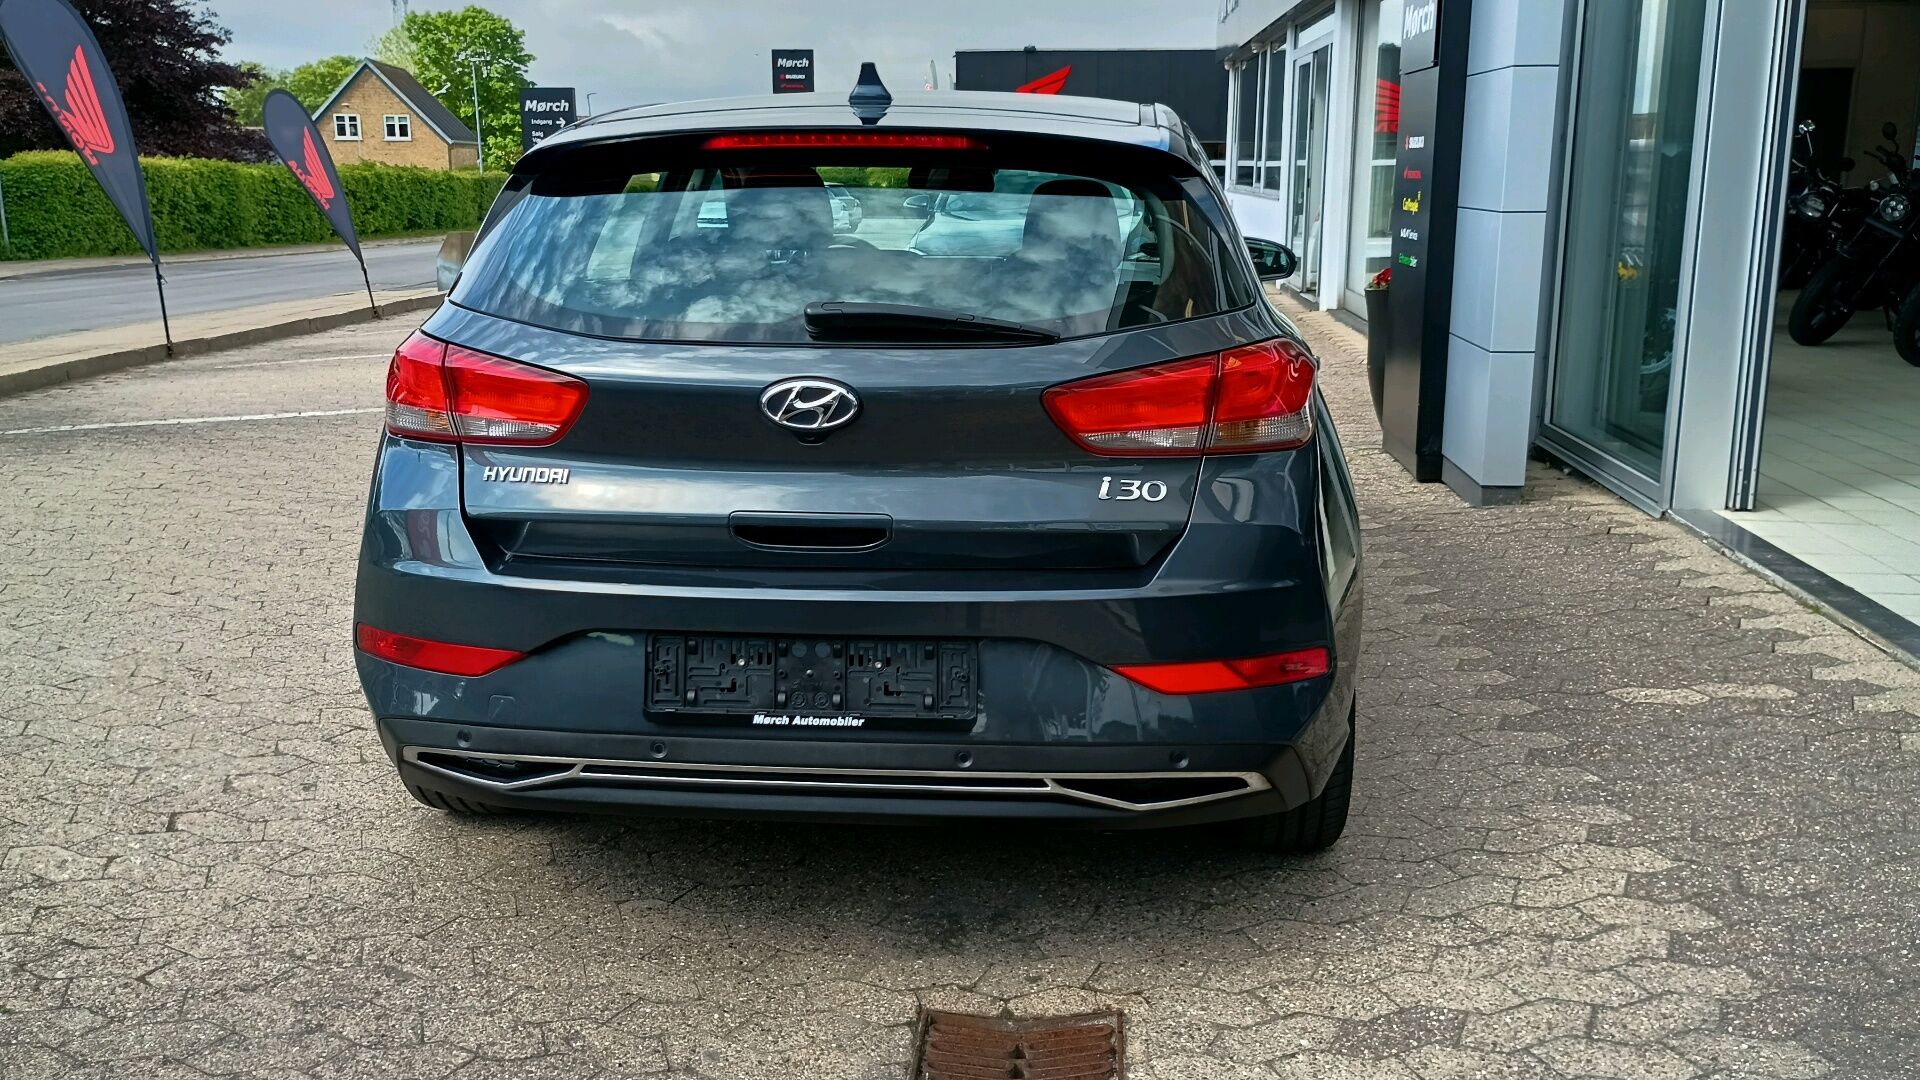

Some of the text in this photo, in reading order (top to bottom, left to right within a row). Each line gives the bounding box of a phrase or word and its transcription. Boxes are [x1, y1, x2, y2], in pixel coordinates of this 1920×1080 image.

[1403, 1, 1436, 40] Mørch
[777, 57, 809, 68] Mørch
[524, 99, 570, 112] Mørch
[531, 118, 553, 126] Indgang
[531, 130, 544, 138] Salg
[482, 466, 570, 485] HYUNDAI
[1098, 476, 1167, 502] i30
[753, 715, 865, 727] Mørch Automobiler
